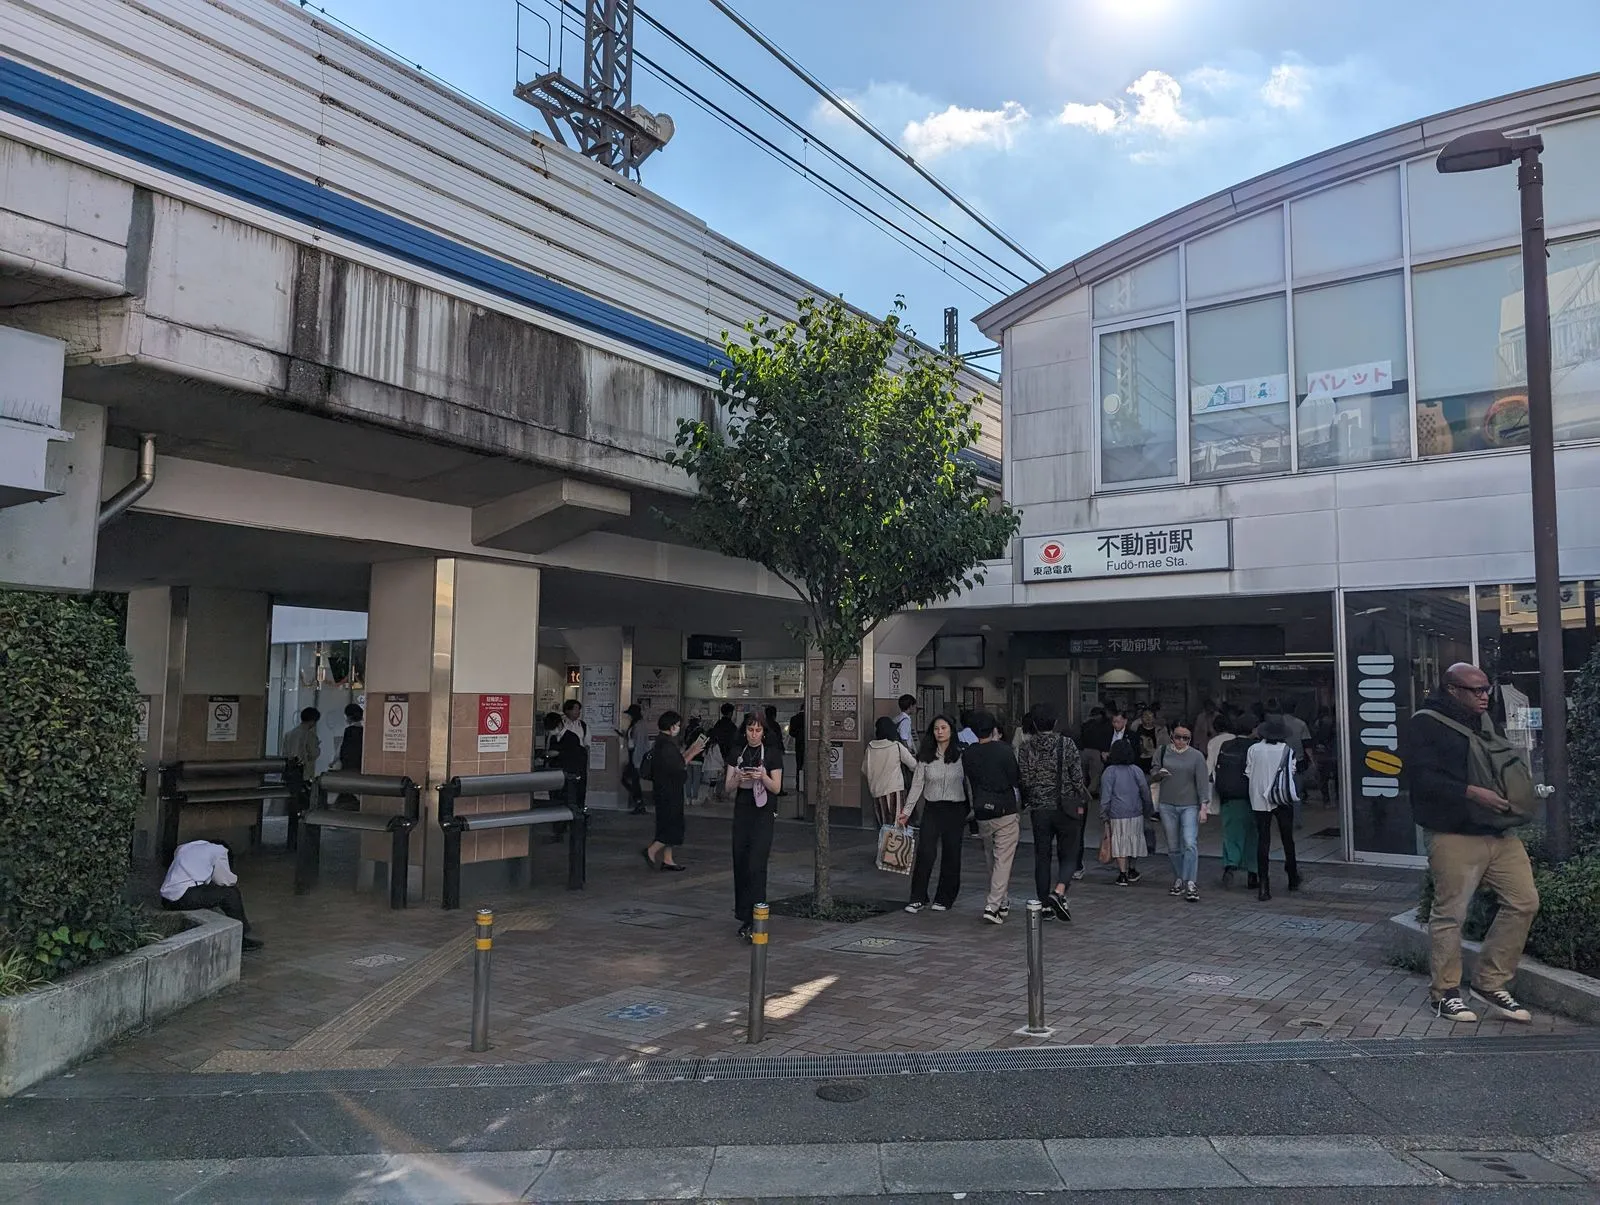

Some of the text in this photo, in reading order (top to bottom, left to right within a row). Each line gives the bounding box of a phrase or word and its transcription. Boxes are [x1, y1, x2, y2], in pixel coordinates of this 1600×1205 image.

[1308, 367, 1388, 394] パレット
[1097, 528, 1194, 559] 不動前駅
[1033, 564, 1073, 576] 東急電鉄
[1165, 556, 1188, 568] Sta.
[1107, 637, 1161, 652] 不動前駅
[1357, 654, 1403, 798] DOUTOR
